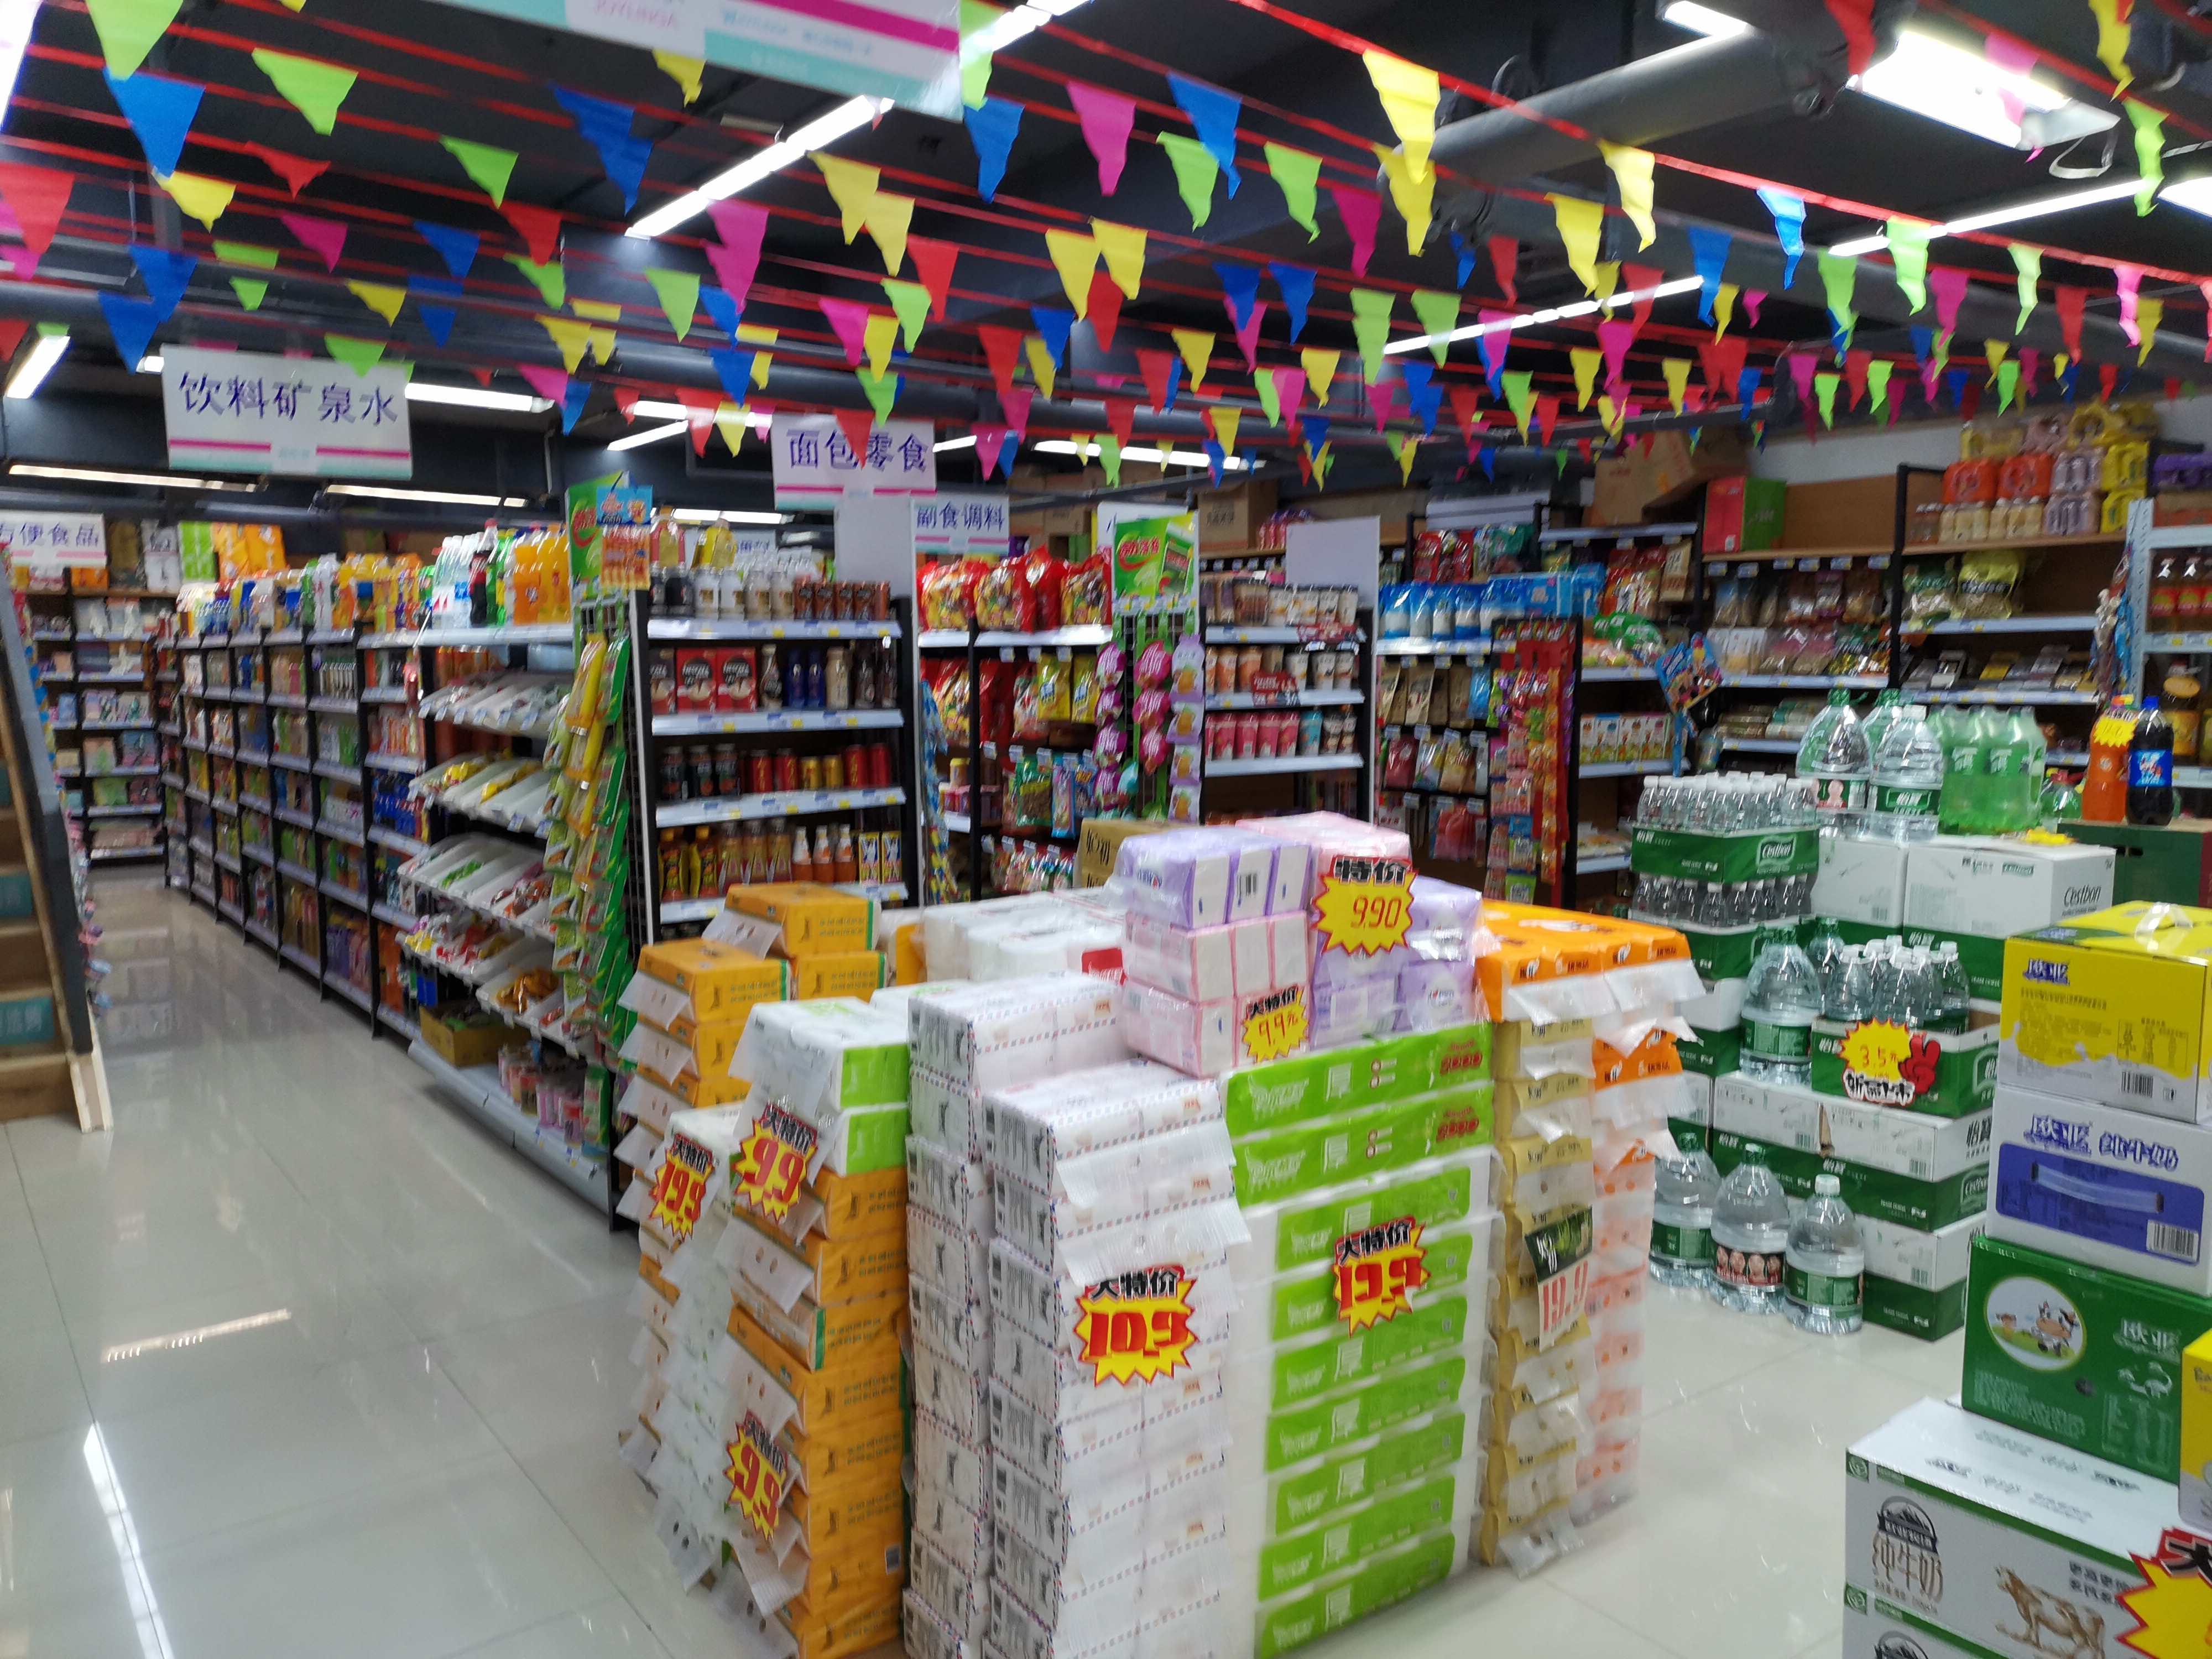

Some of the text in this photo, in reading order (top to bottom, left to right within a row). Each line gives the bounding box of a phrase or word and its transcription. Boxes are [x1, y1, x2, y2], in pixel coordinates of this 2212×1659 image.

[179, 371, 398, 426] 饮料矿泉水
[786, 429, 930, 474] 面包零食
[916, 500, 1005, 531] 副食调料
[1333, 858, 1408, 886] 特价
[1350, 894, 1402, 928] 9.90
[671, 1134, 710, 1175] 大特价
[761, 1106, 814, 1156] 大特价
[657, 1160, 706, 1222] 19.9
[1337, 1220, 1411, 1267] 大特价
[1089, 1270, 1177, 1303] 大特价
[1339, 1256, 1422, 1311] 19.9
[1543, 1260, 1589, 1332] 19.9
[1089, 1312, 1189, 1357] 10.9
[745, 1420, 785, 1475] 大特价
[734, 1444, 780, 1528] 9.9
[1872, 1531, 1944, 1604] 纯牛奶
